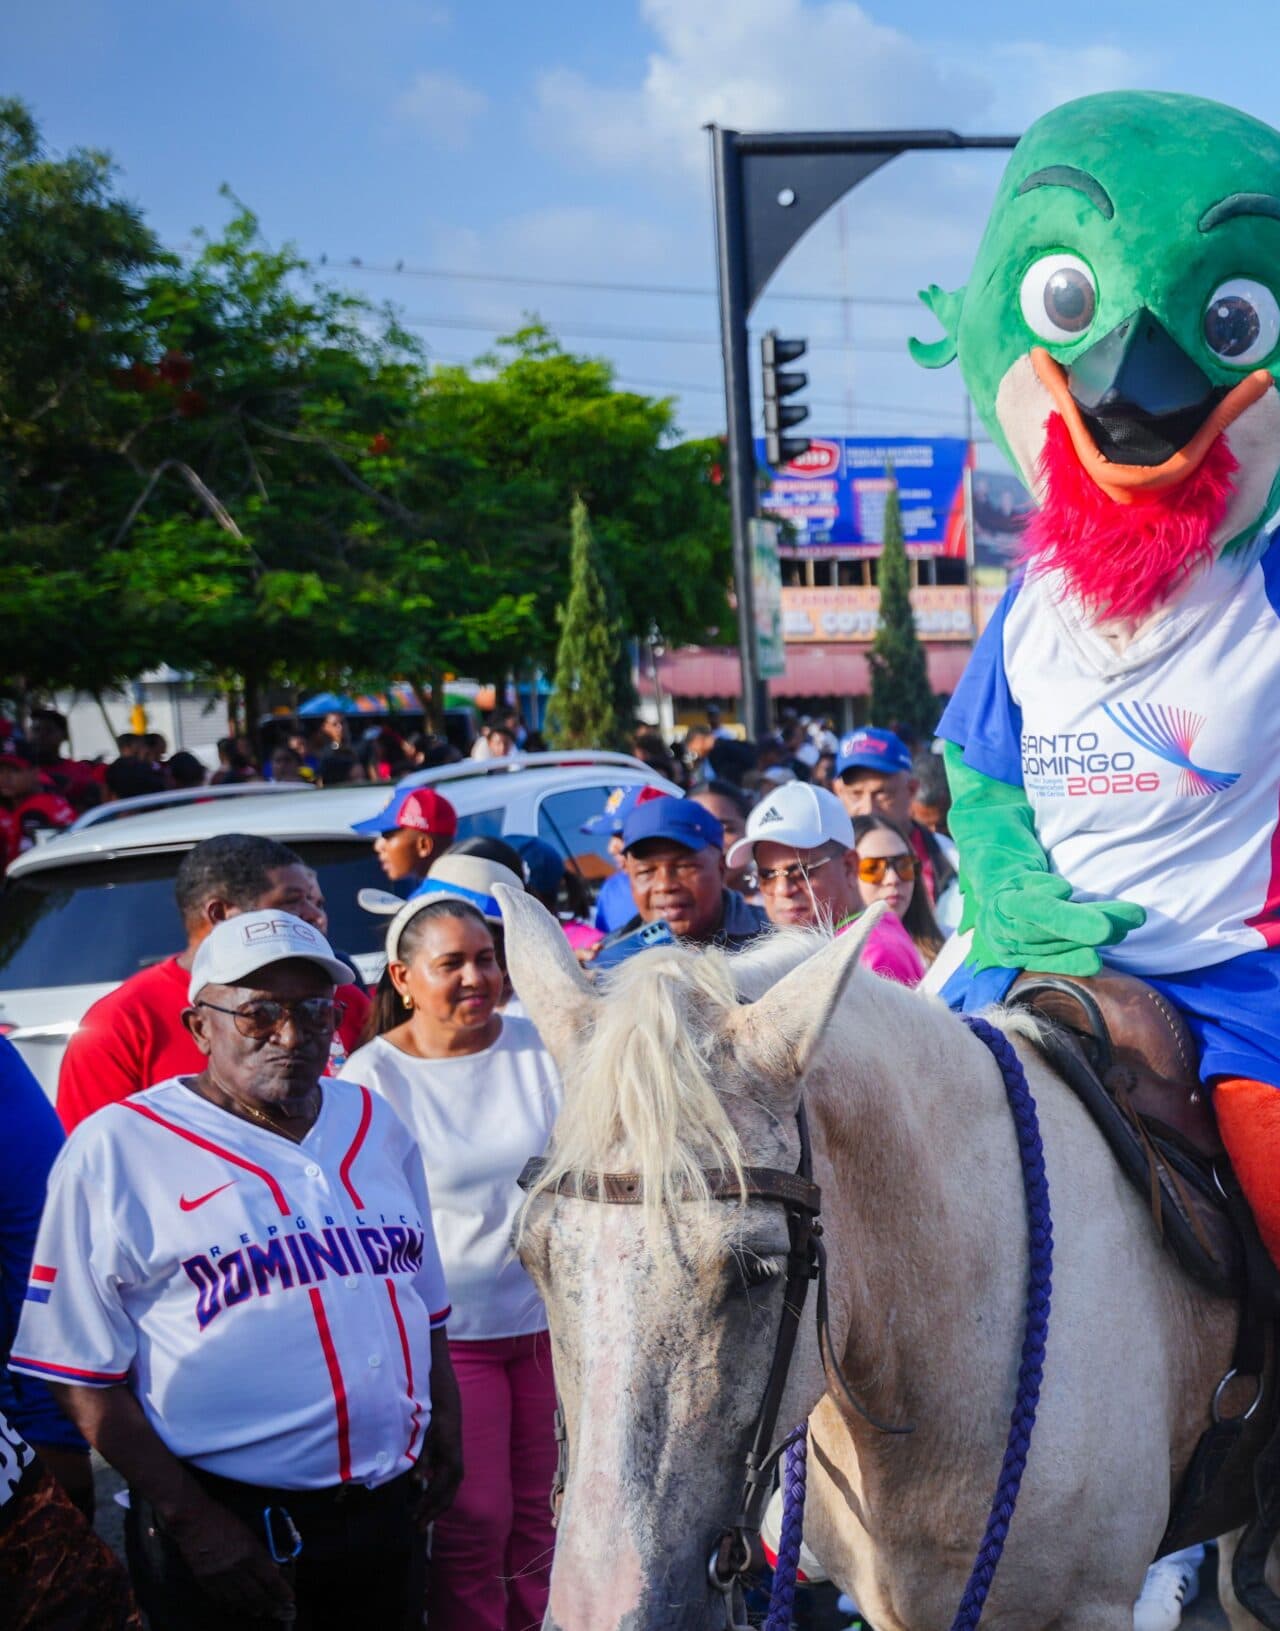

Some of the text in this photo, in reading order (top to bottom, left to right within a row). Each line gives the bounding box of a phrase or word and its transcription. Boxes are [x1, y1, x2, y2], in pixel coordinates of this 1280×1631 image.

[1066, 771, 1160, 796] 2026
[245, 920, 316, 944] PFG
[210, 1214, 422, 1258] REPÚBLIC
[181, 1226, 425, 1333] DOMINICAN
